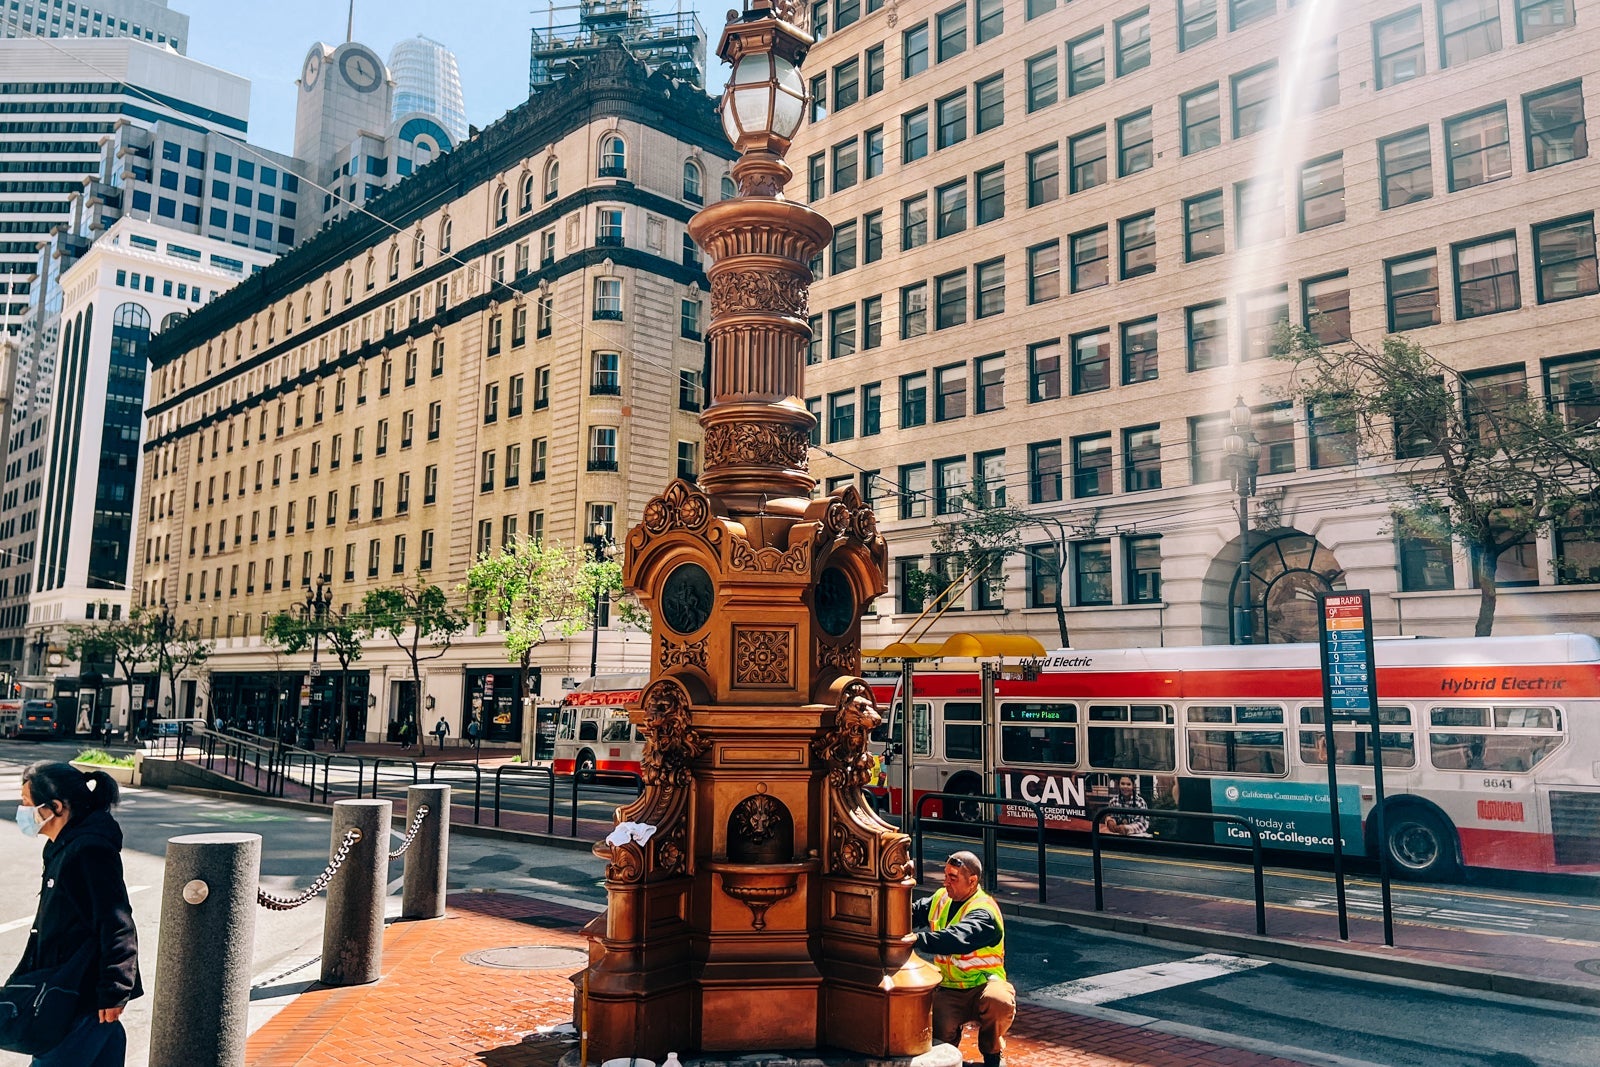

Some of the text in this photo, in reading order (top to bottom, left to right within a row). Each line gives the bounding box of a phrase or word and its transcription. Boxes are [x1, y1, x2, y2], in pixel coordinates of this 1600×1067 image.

[1340, 596, 1361, 605] RAPID
[1332, 631, 1338, 641] 6
[1332, 642, 1338, 651] 7
[1053, 656, 1093, 667] Electric
[1333, 653, 1340, 663] 9
[1335, 664, 1340, 674] L
[1335, 675, 1342, 685] N
[1441, 676, 1566, 693] Hybrid Electric
[1021, 710, 1040, 719] Ferry
[1041, 711, 1060, 719] Plaza
[1483, 778, 1513, 789] 8641
[1004, 774, 1086, 807] I CAN
[1241, 790, 1274, 799] California
[1274, 793, 1314, 803] Community
[1006, 810, 1021, 818] STILL
[1044, 813, 1072, 822] SCHOOL.
[1018, 805, 1044, 814] COLLE
[1044, 806, 1066, 815] CREDIT
[1065, 809, 1086, 817] WHILE
[1255, 818, 1284, 831] today
[1285, 820, 1296, 830] at
[1228, 827, 1346, 847] ICanoToCollege.co
